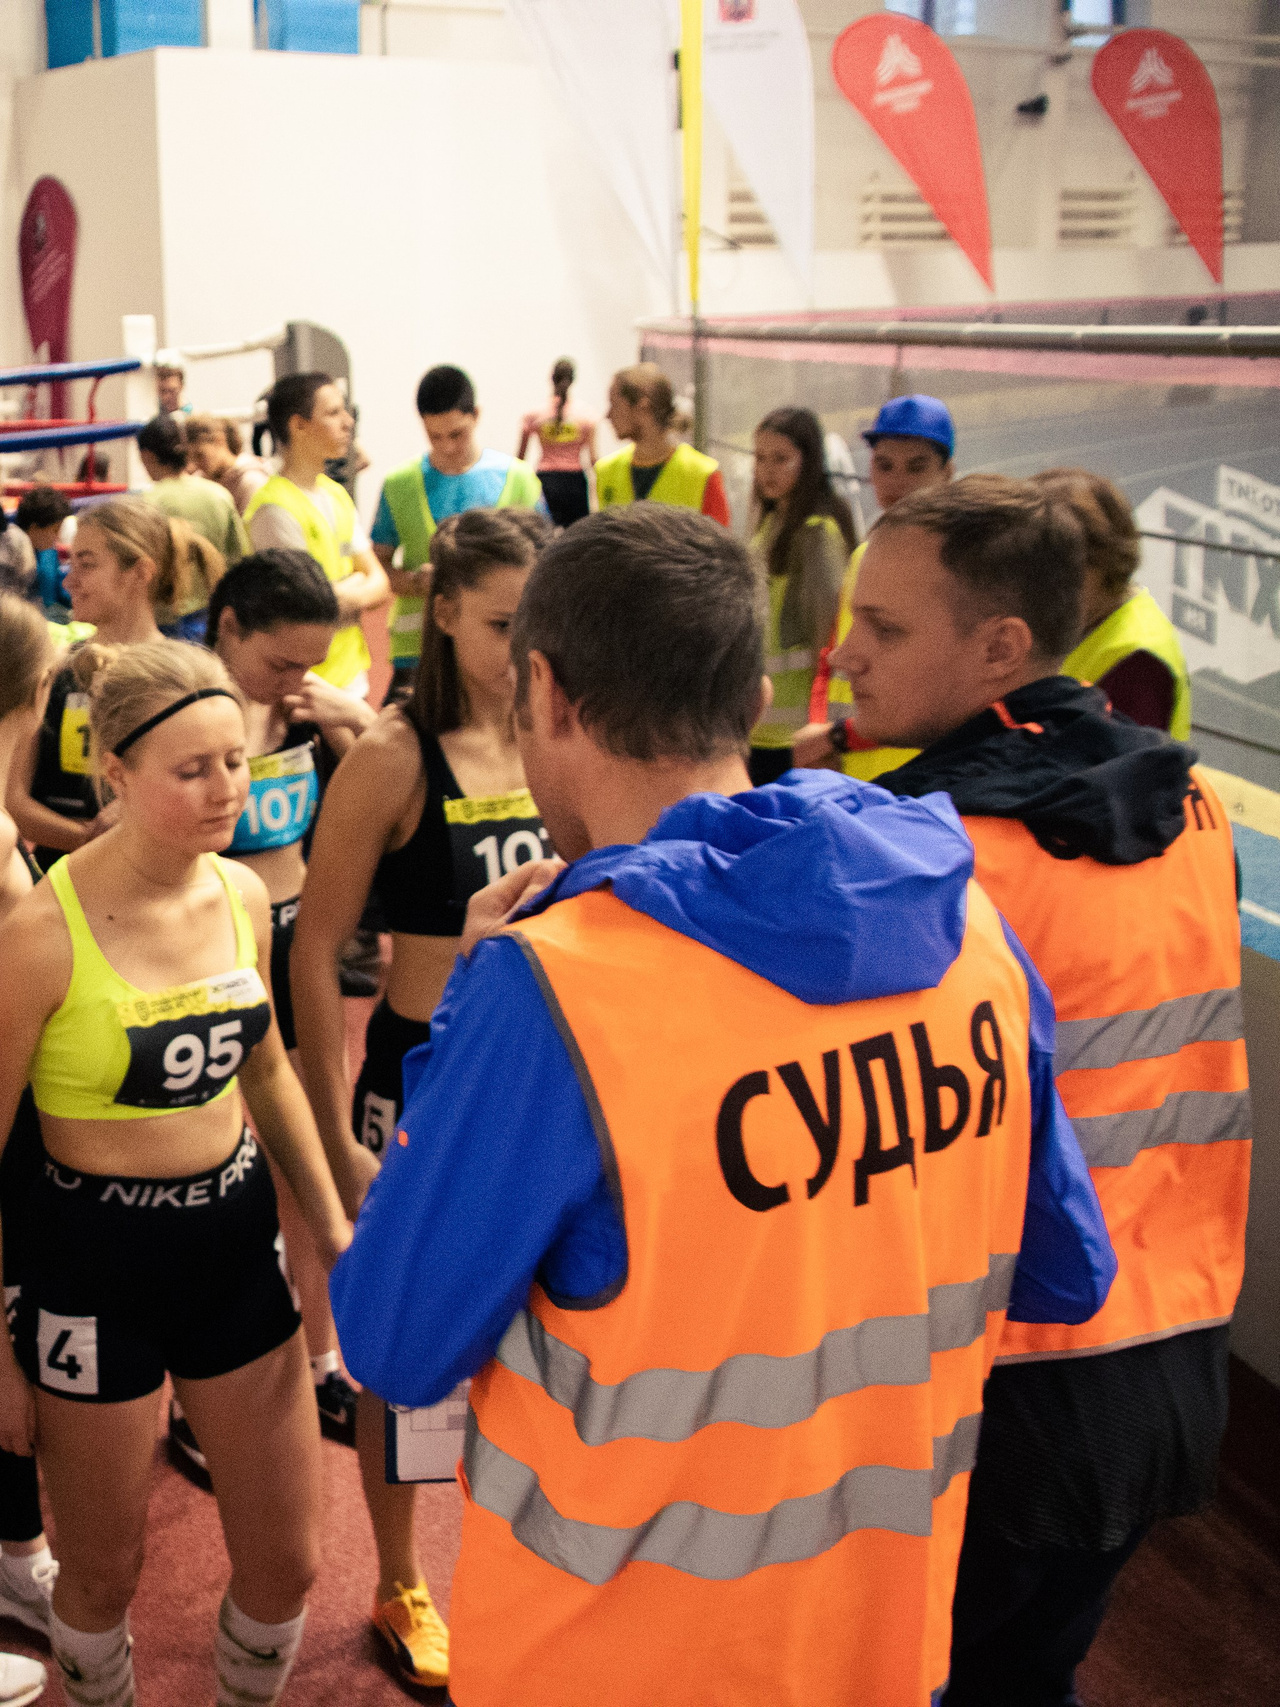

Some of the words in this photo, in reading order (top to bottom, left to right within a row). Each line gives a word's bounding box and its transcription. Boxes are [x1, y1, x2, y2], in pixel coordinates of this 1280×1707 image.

[243, 779, 309, 835] 107
[472, 827, 562, 885] 10
[161, 1019, 243, 1091] 95
[716, 1000, 1008, 1214] СУДЬЯ
[100, 1178, 212, 1208] NIKE
[47, 1329, 82, 1380] 4
